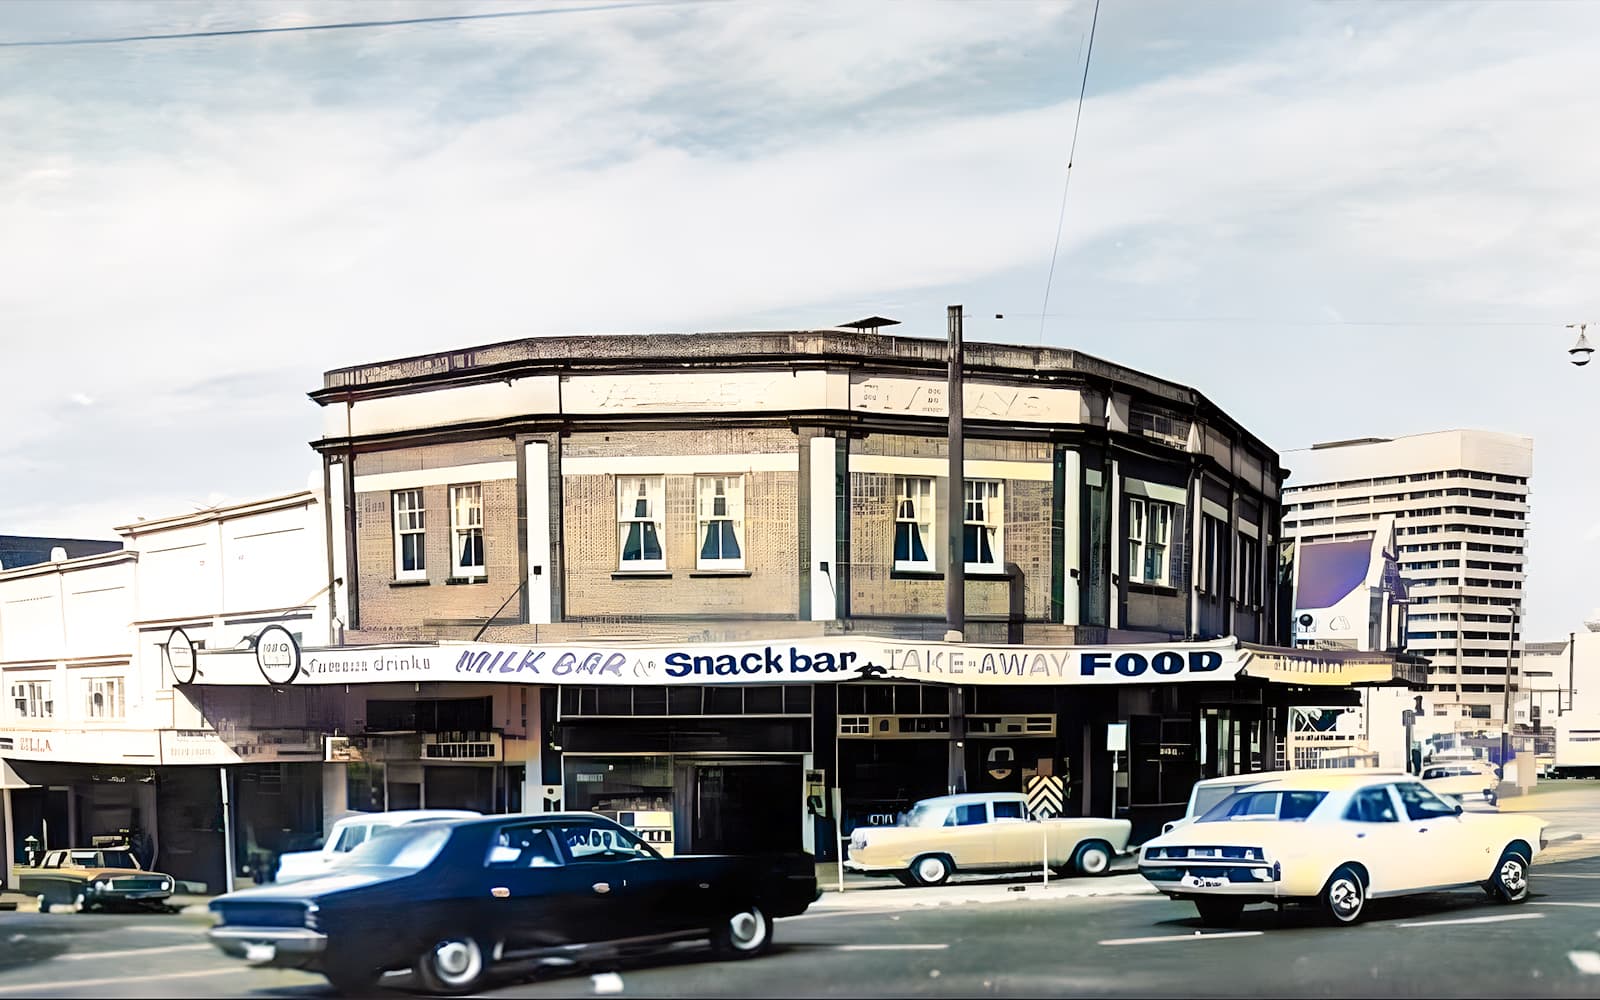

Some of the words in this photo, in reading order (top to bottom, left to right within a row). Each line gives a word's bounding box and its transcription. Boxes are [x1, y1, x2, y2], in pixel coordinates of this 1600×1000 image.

[456, 650, 546, 674] MILK
[665, 647, 783, 677] Snack
[790, 647, 857, 673] bar
[1080, 651, 1223, 677] FOOD
